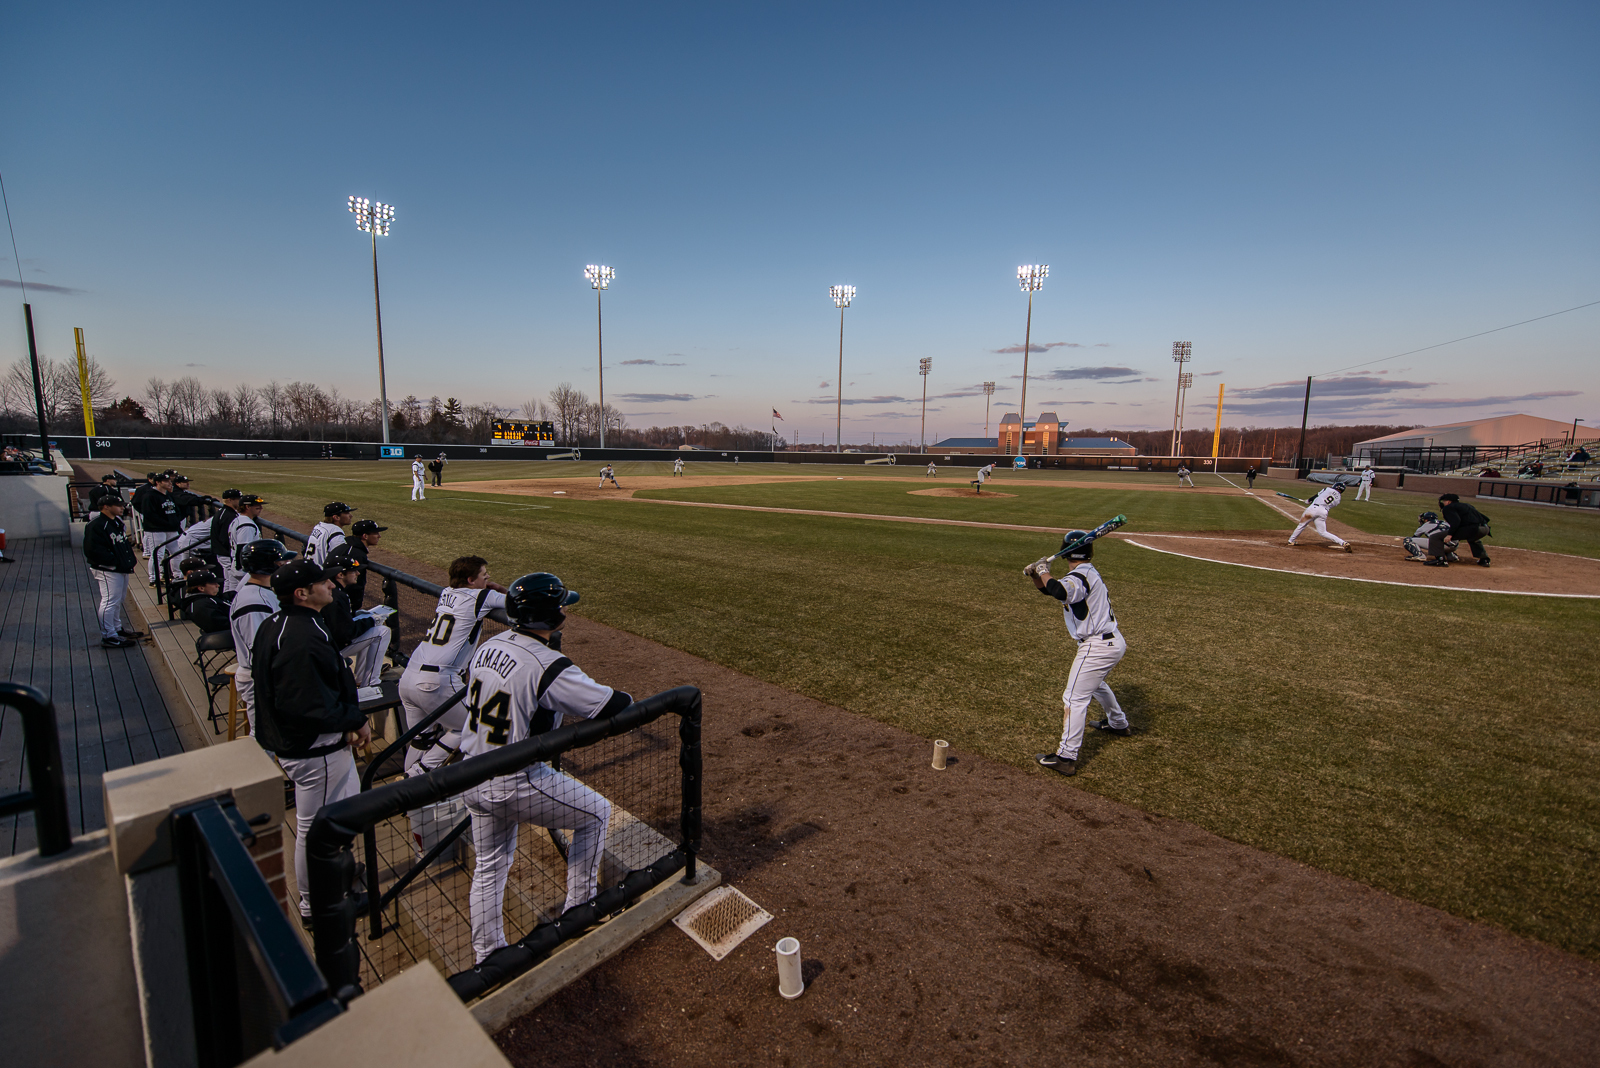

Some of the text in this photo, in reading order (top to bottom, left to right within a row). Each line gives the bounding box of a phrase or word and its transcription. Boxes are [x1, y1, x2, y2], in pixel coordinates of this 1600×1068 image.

[95, 440, 111, 448] 340
[1324, 495, 1335, 505] 9
[474, 647, 518, 680] AMARO
[468, 677, 513, 746] 44
